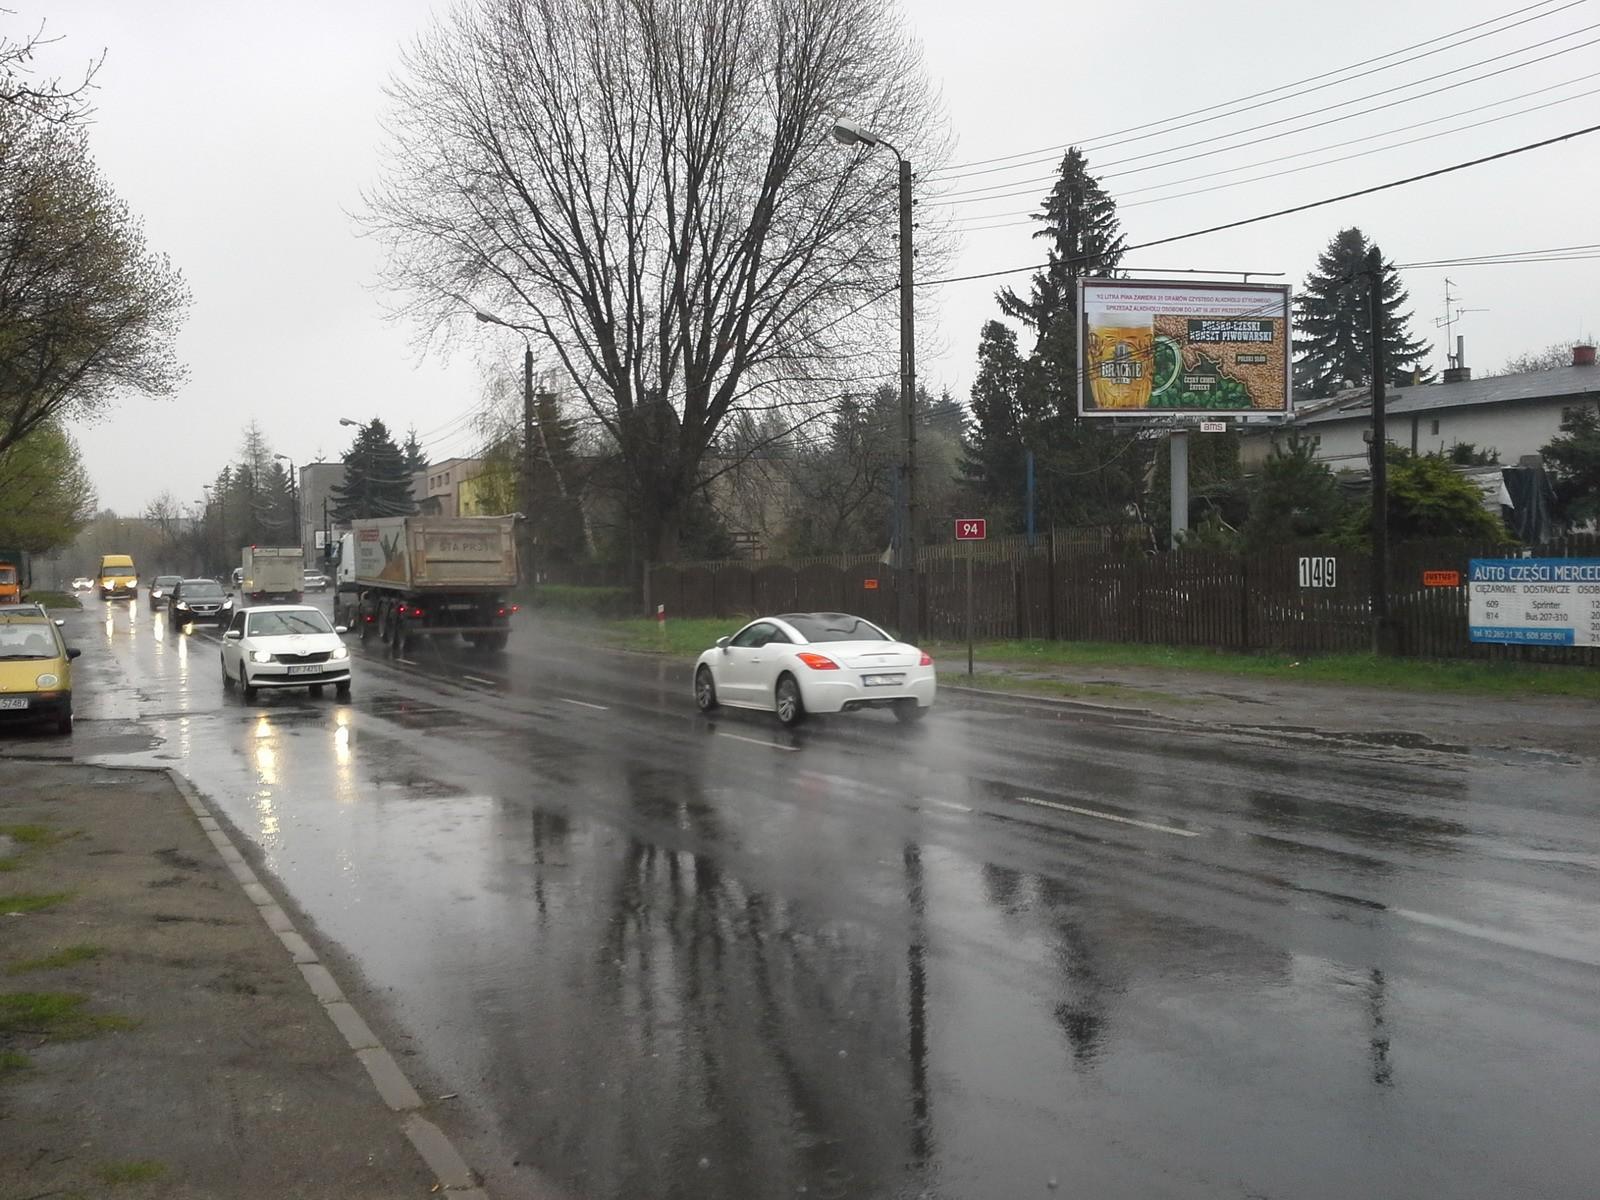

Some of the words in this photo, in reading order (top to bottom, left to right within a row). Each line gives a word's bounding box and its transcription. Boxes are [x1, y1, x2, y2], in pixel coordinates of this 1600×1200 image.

[1222, 331, 1272, 341] PIWOWARSKI
[1101, 363, 1142, 377] BRACKIE
[1203, 423, 1223, 431] ams
[963, 523, 978, 536] 94
[1300, 558, 1335, 587] 149
[1474, 566, 1505, 581] AUTO
[1509, 564, 1550, 582] CZĘŚCI
[1475, 584, 1517, 594] CIĘŻAROWE
[1523, 585, 1570, 594] DOSTAWCZE
[1486, 600, 1499, 608] 609
[1532, 600, 1561, 610] Sprinter
[1486, 611, 1499, 620] 814
[1526, 612, 1538, 621] Bus
[1539, 612, 1568, 622] 207-310
